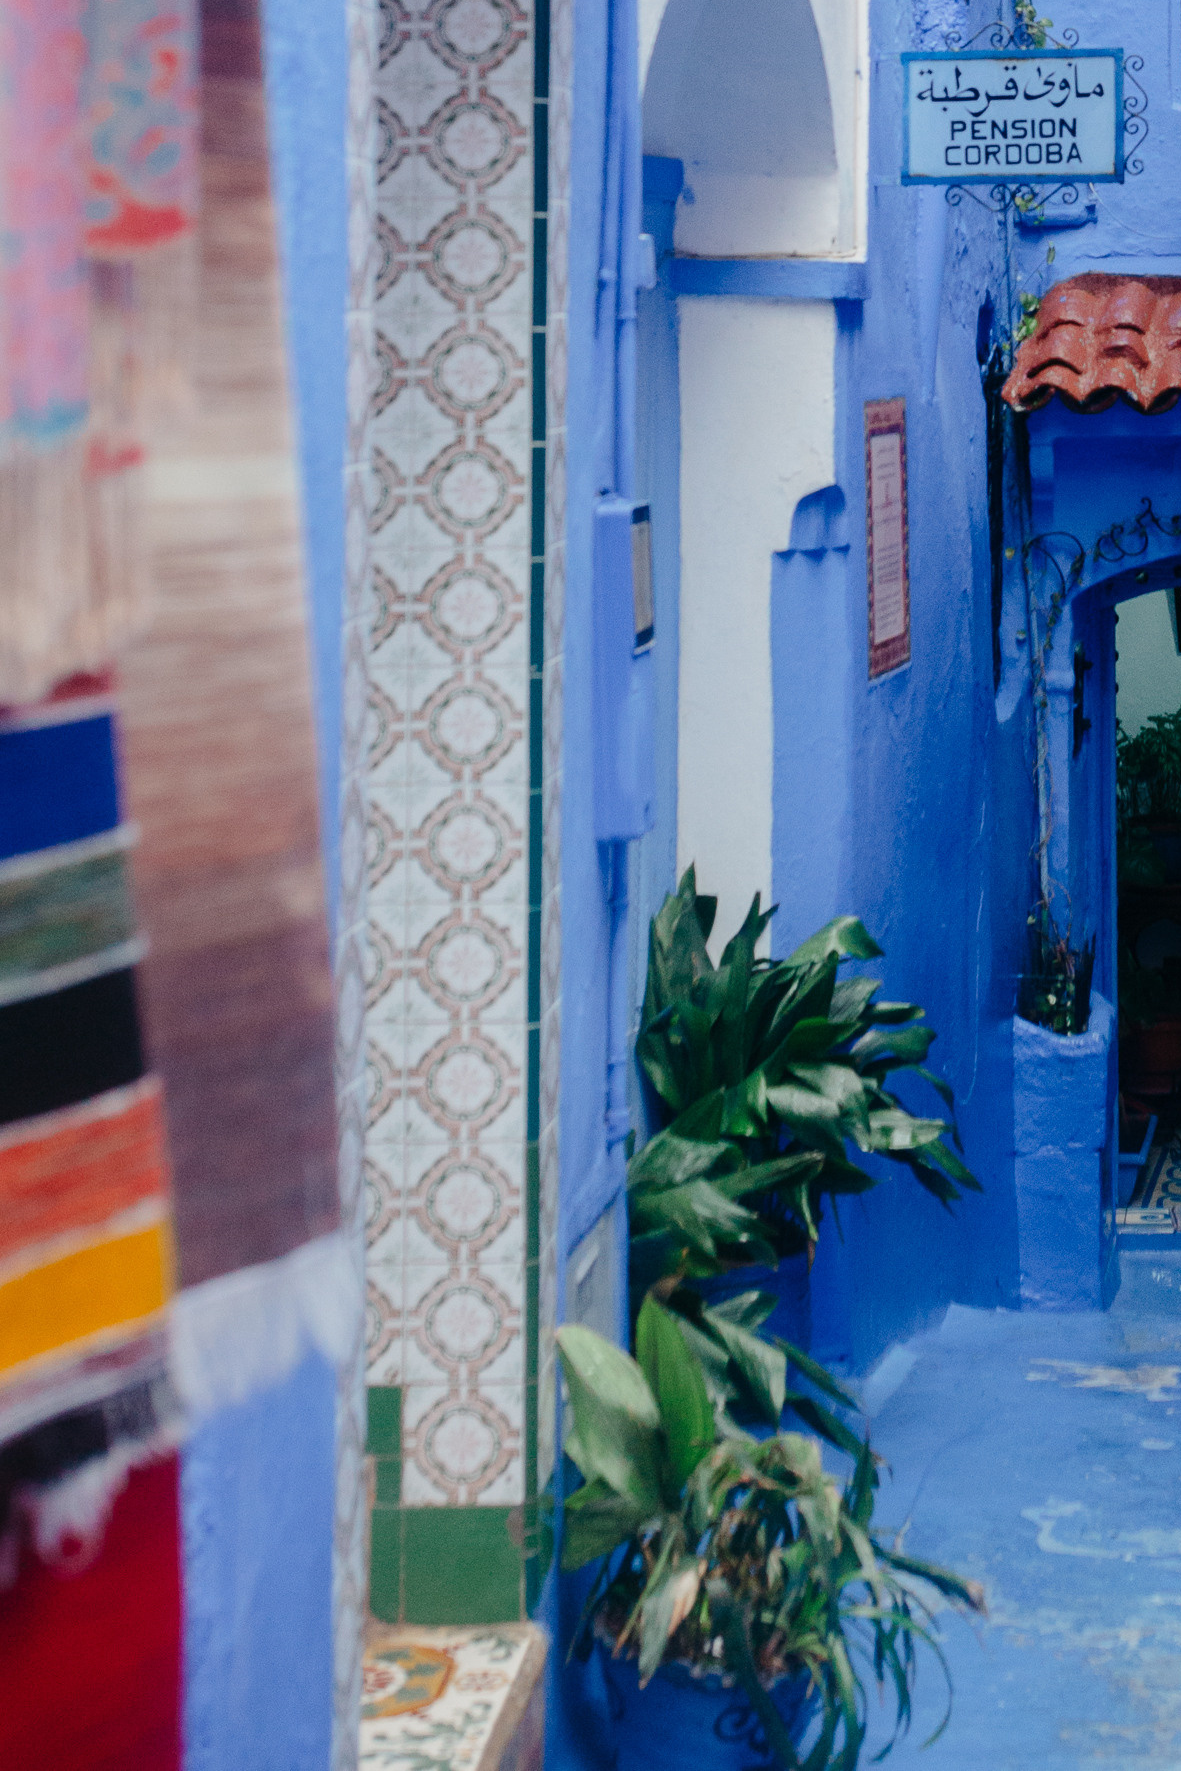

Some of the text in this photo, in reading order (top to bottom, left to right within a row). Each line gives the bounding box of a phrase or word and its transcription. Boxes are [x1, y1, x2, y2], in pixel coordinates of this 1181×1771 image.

[916, 64, 1019, 118] قرطبة
[950, 117, 1077, 141] PENSION
[944, 142, 1083, 166] CORDOBA
